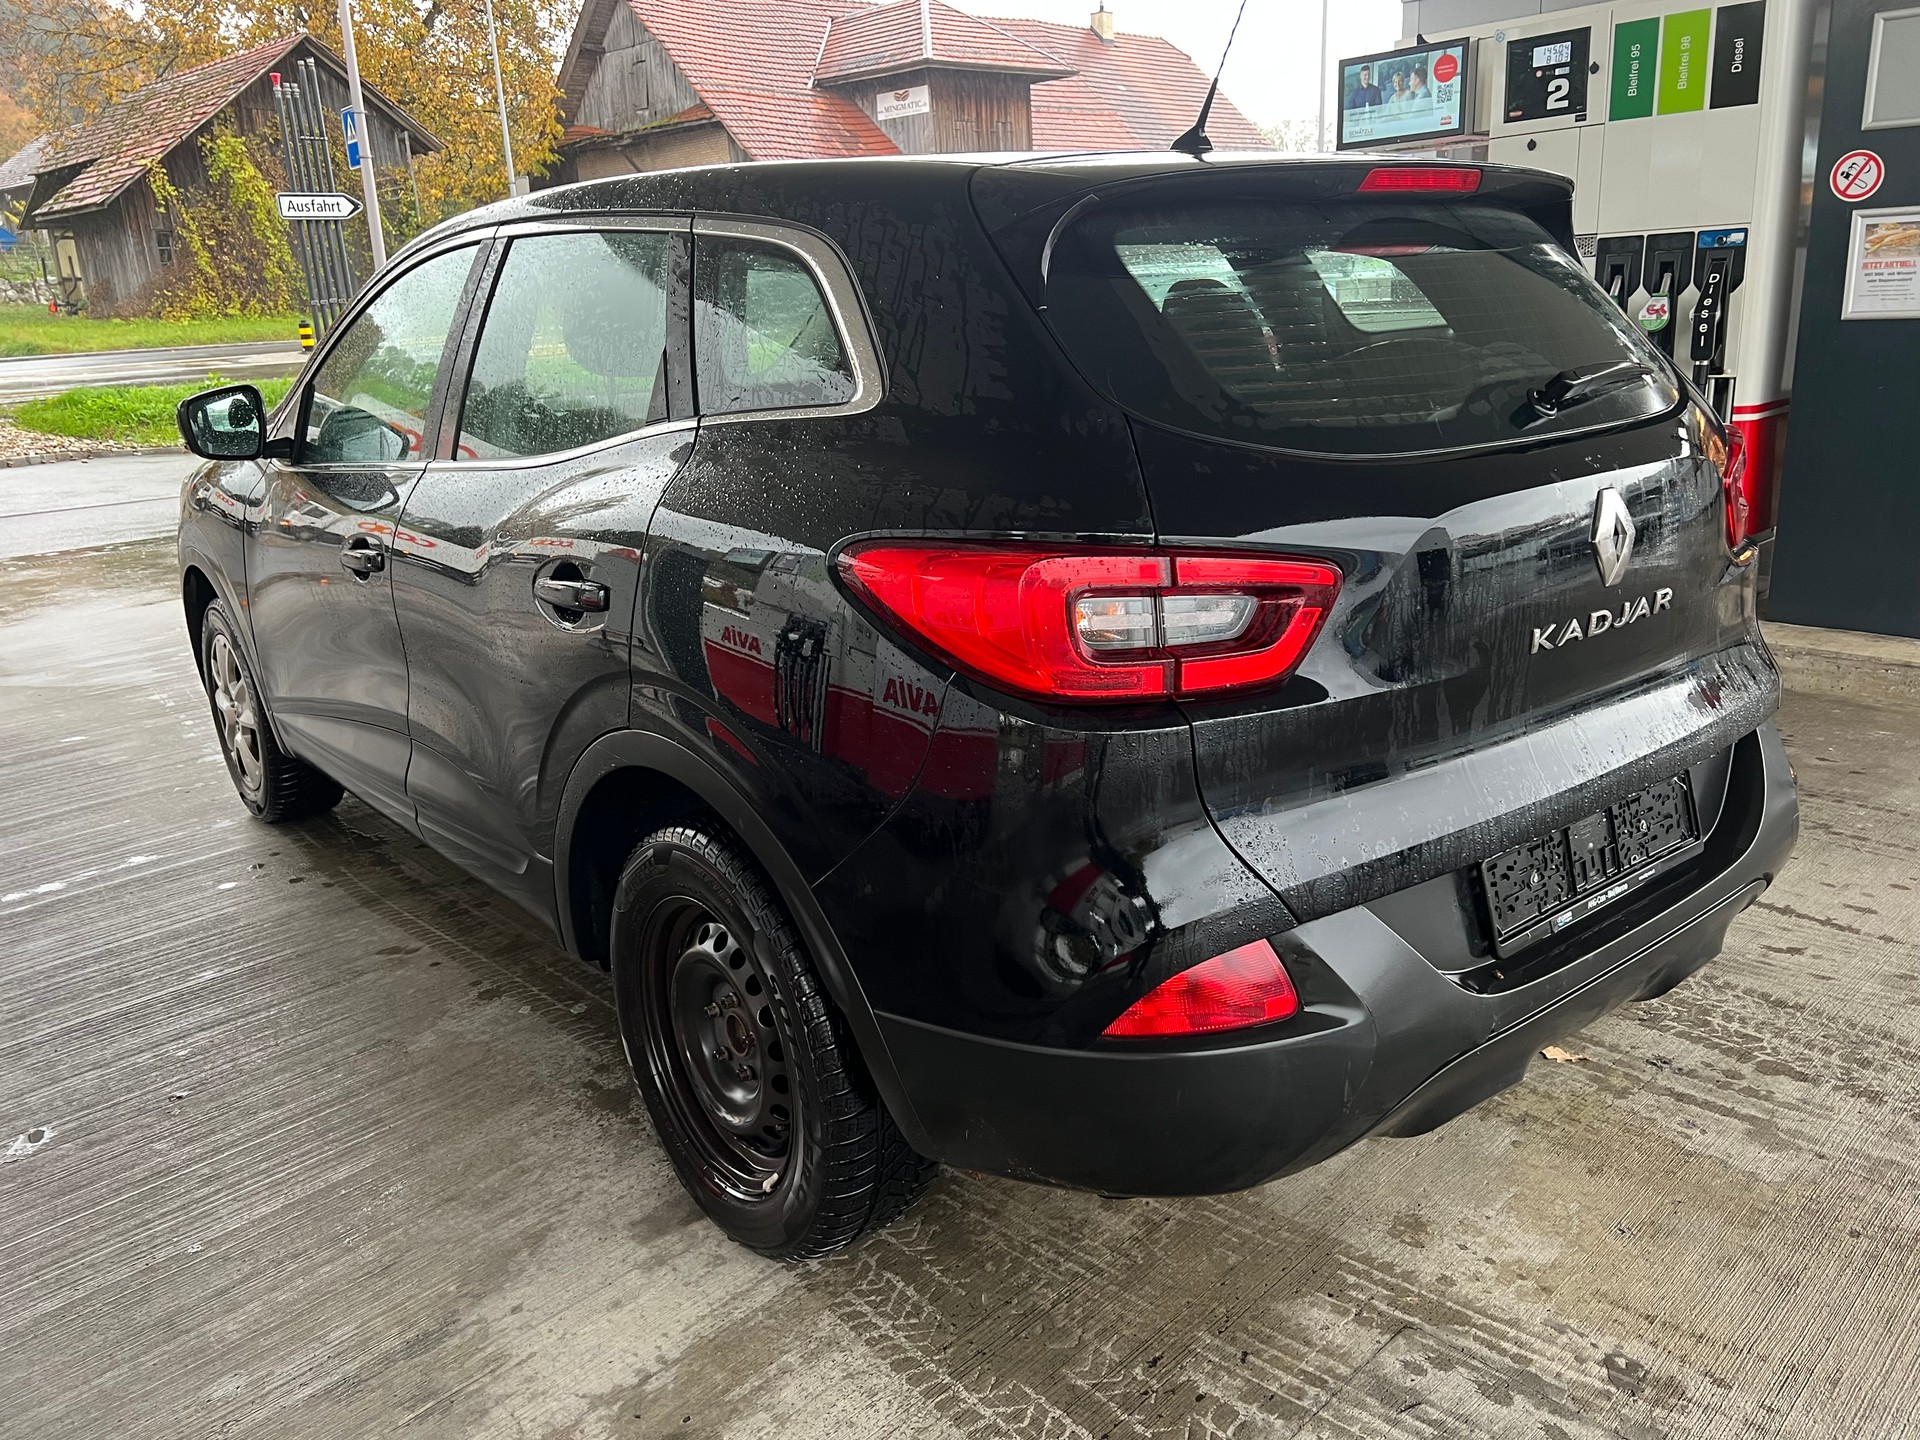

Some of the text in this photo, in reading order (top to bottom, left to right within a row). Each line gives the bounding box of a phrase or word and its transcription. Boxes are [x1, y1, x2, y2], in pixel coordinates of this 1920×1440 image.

[1627, 43, 1641, 97] Bleifrei 95
[1677, 35, 1691, 90] Bleifrei 98
[1731, 37, 1745, 73] Diesel
[1546, 77, 1570, 110] 2
[287, 198, 342, 213] Ausfahrt
[1698, 273, 1721, 347] Diesel
[1530, 587, 1673, 655] KADJAR
